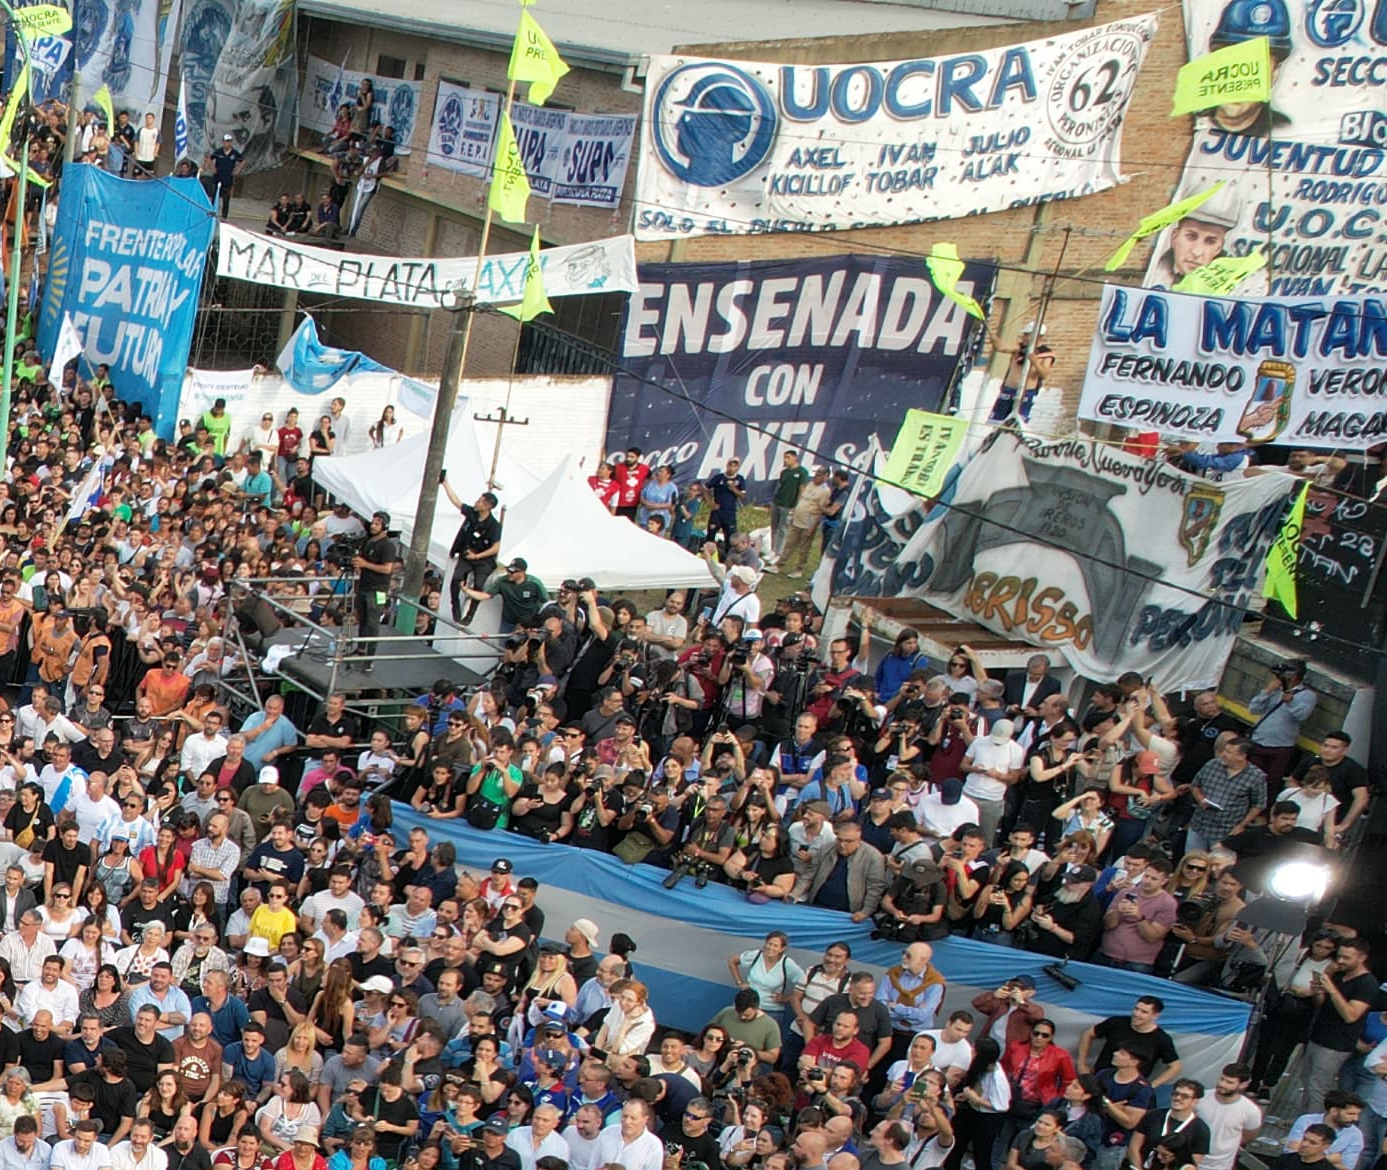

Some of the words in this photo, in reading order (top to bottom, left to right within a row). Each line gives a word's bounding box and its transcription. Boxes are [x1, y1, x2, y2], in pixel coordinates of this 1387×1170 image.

[779, 46, 1037, 122] UOCRA
[1069, 59, 1121, 113] 62
[785, 147, 847, 169] AXEL
[877, 142, 937, 167] IVAN
[963, 126, 1031, 158] JULIO
[1200, 129, 1386, 179] JUVENTUD
[769, 172, 854, 197] KICILLOF
[865, 167, 937, 193] TOBAR
[959, 152, 1020, 183] ALAK
[228, 237, 303, 288] MAR
[337, 259, 438, 304] PLATA
[623, 269, 975, 358] ENSENADA
[1105, 288, 1169, 348] LA
[745, 363, 824, 406] CON
[1099, 352, 1245, 393] FERNANDO
[1098, 394, 1226, 433] ESPINOZA
[697, 420, 827, 481] AXEL
